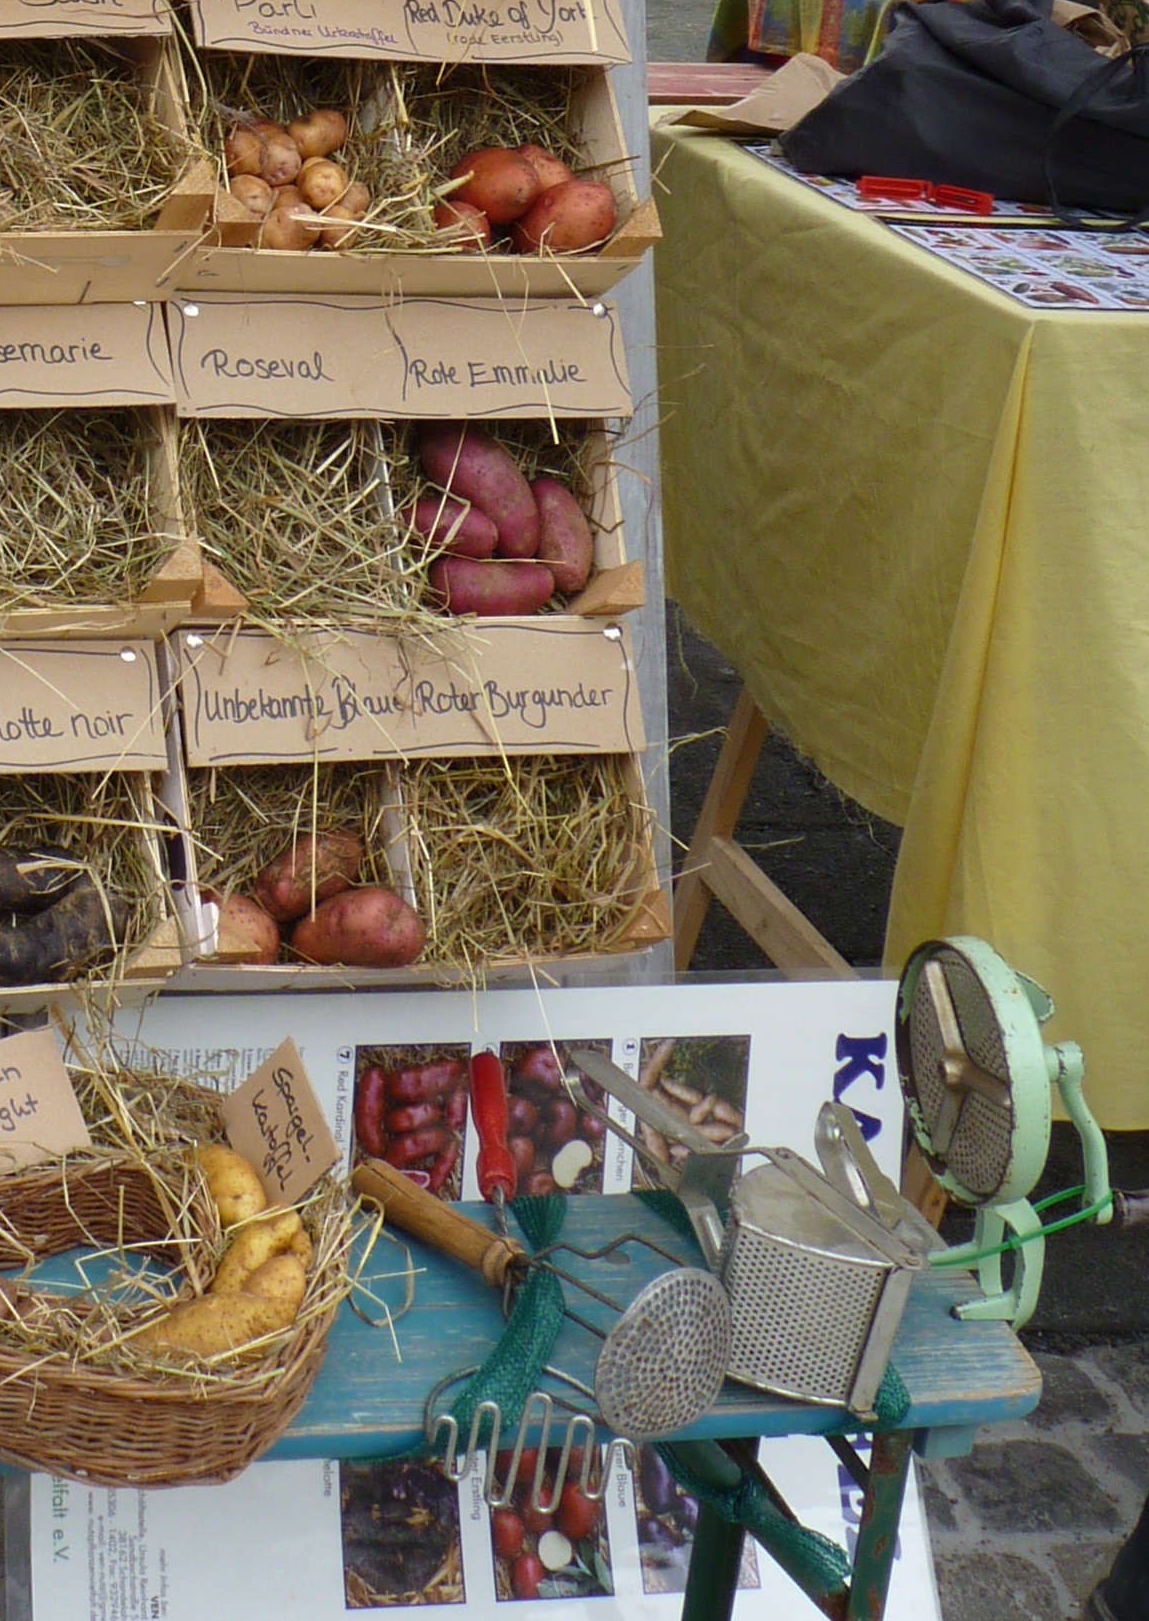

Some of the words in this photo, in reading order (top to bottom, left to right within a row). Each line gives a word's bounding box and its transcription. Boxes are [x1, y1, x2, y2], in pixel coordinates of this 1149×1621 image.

[442, 0, 504, 28] Duke
[507, 0, 530, 30] of
[491, 30, 564, 46] Eerstling)
[201, 349, 333, 381] Roseval
[410, 359, 461, 386] Rote
[416, 681, 482, 717] Roter
[484, 679, 613, 728] Burgunder
[72, 711, 133, 740] noir
[338, 1071, 348, 1092] Red
[335, 1095, 347, 1143] Kardinal
[471, 1477, 483, 1520] Erstling
[616, 1474, 627, 1507] Blaue
[151, 1595, 159, 1619] VEN
